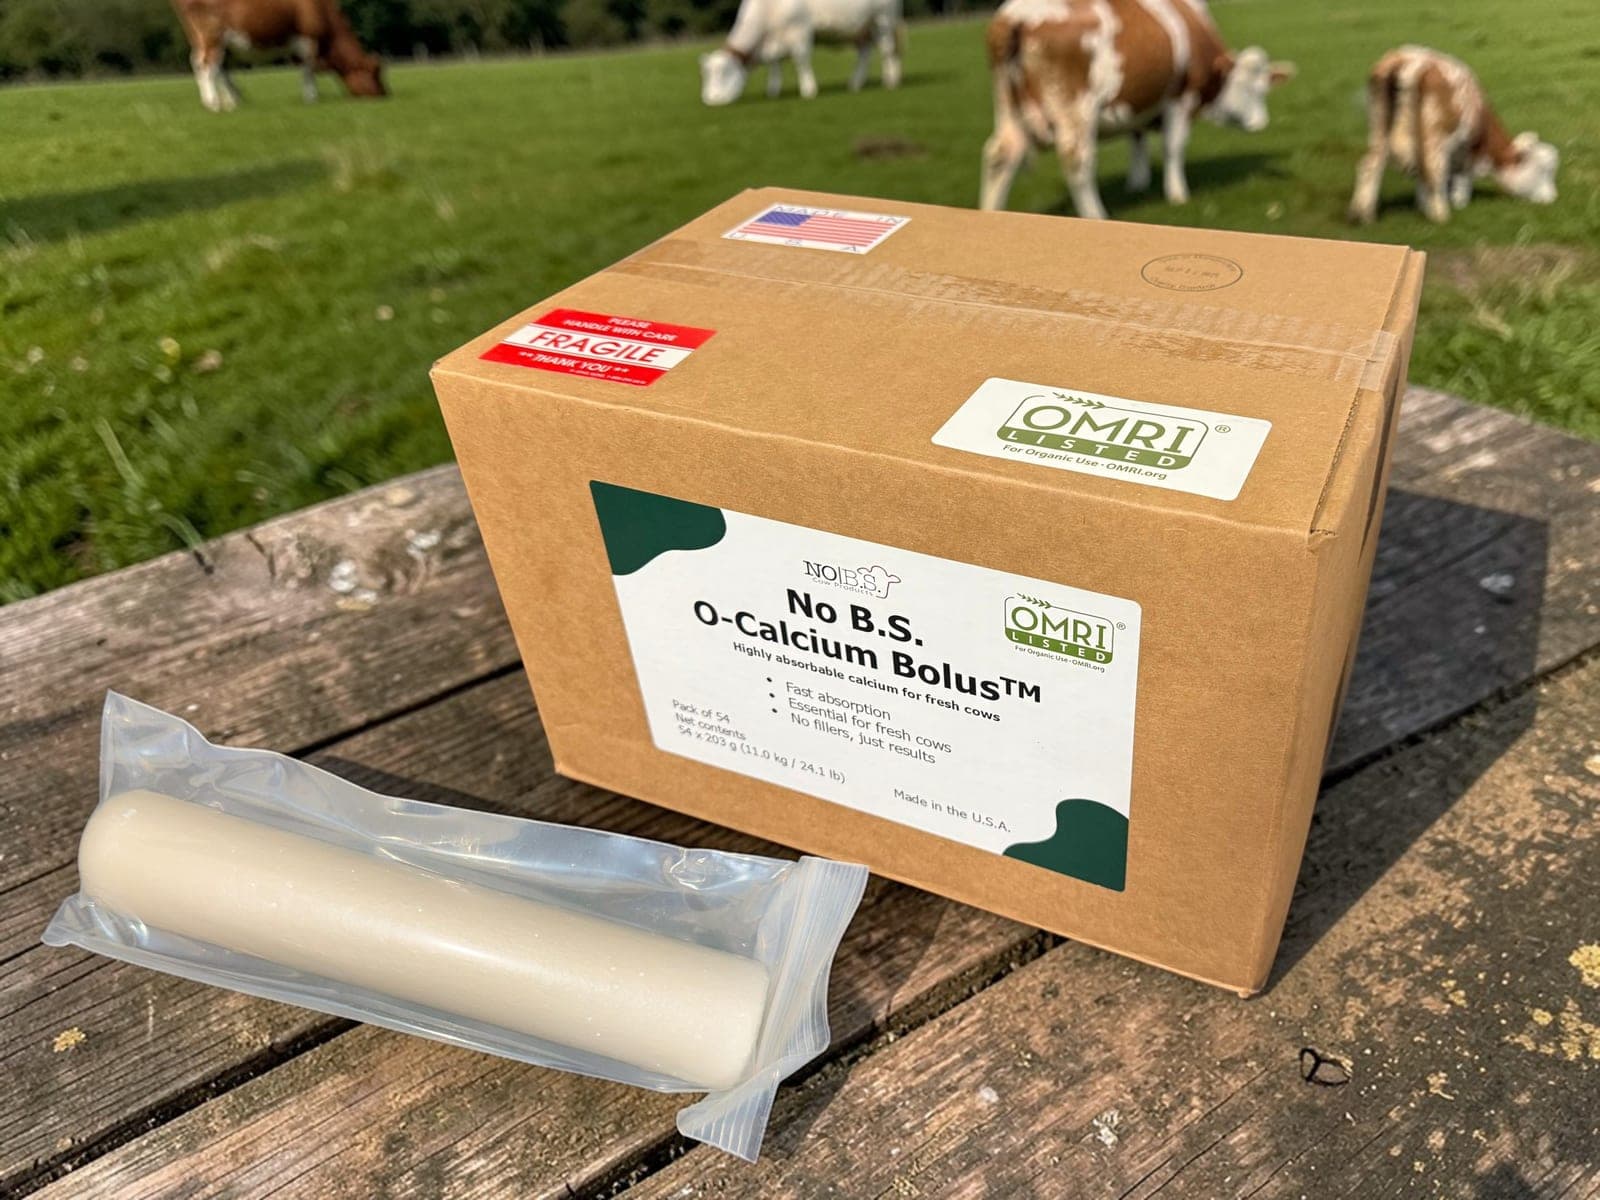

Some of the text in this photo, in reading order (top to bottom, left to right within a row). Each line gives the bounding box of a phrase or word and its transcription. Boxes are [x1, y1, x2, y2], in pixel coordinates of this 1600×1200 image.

[775, 206, 849, 219] MADE
[563, 320, 679, 341] HANDLE WITH CARE
[609, 317, 652, 329] PLEASE
[528, 331, 667, 362] FRAGILE
[531, 354, 613, 373] THANK YOU
[1022, 405, 1194, 453] OMRI
[1002, 444, 1168, 480] For Organic Use OMRI.org
[1007, 430, 1176, 467] LISTED
[693, 600, 879, 669] O-Calcium
[786, 588, 924, 646] No B.S.
[1011, 606, 1107, 649] OMRI
[1012, 632, 1106, 661] LISTED
[1014, 645, 1026, 653] For
[1027, 647, 1054, 660] Organic
[1055, 655, 1069, 663] Use
[733, 641, 1001, 722] Highly absorbable calcium for fresh cows
[672, 699, 698, 715] Pack
[701, 708, 713, 720] of
[786, 681, 892, 720] Fast absorption
[675, 713, 747, 741] Net contents
[788, 697, 952, 753] Essential for fresh cows
[791, 713, 937, 764] No fillers, just results
[706, 733, 727, 747] 203
[729, 742, 738, 752] g
[740, 742, 771, 760] (11.0
[773, 752, 789, 767] kg
[799, 760, 826, 776] 24.1
[829, 769, 846, 784] lb)
[893, 788, 1011, 833] Made in the U.S.A.
